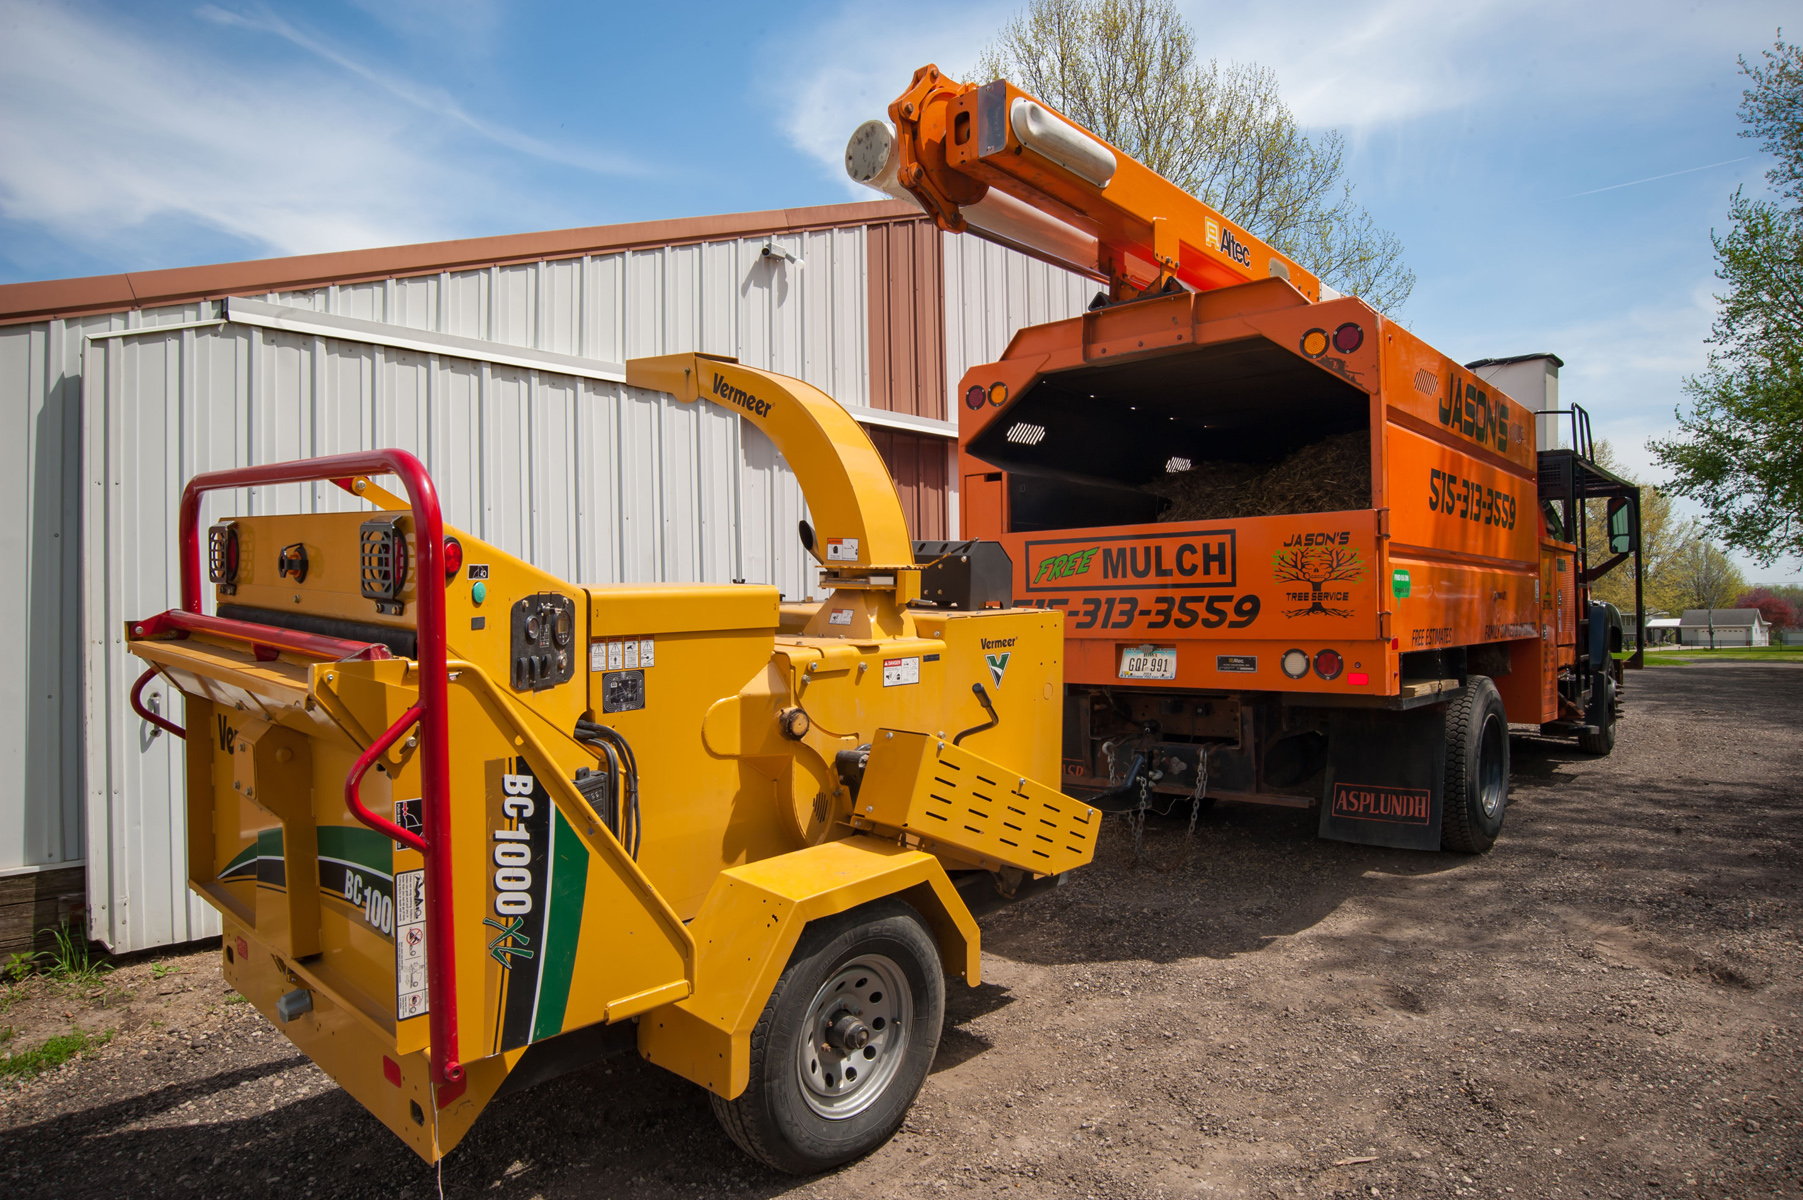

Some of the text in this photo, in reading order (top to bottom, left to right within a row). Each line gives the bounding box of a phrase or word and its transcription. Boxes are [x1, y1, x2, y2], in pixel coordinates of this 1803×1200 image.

[1220, 227, 1250, 268] Altec
[712, 372, 772, 418] Vermeer
[1438, 372, 1509, 453] JASON'S
[1429, 468, 1516, 530] 515-313-3559
[1283, 531, 1350, 547] JASON'S
[1033, 542, 1226, 584] FREE MULCH
[1286, 592, 1349, 601] TREE SERVICE
[981, 637, 1016, 650] Vermeer
[1411, 627, 1453, 647] FREE ESTIMATES
[1128, 657, 1169, 673] GQP 991
[1336, 789, 1428, 818] ASPLUNDH
